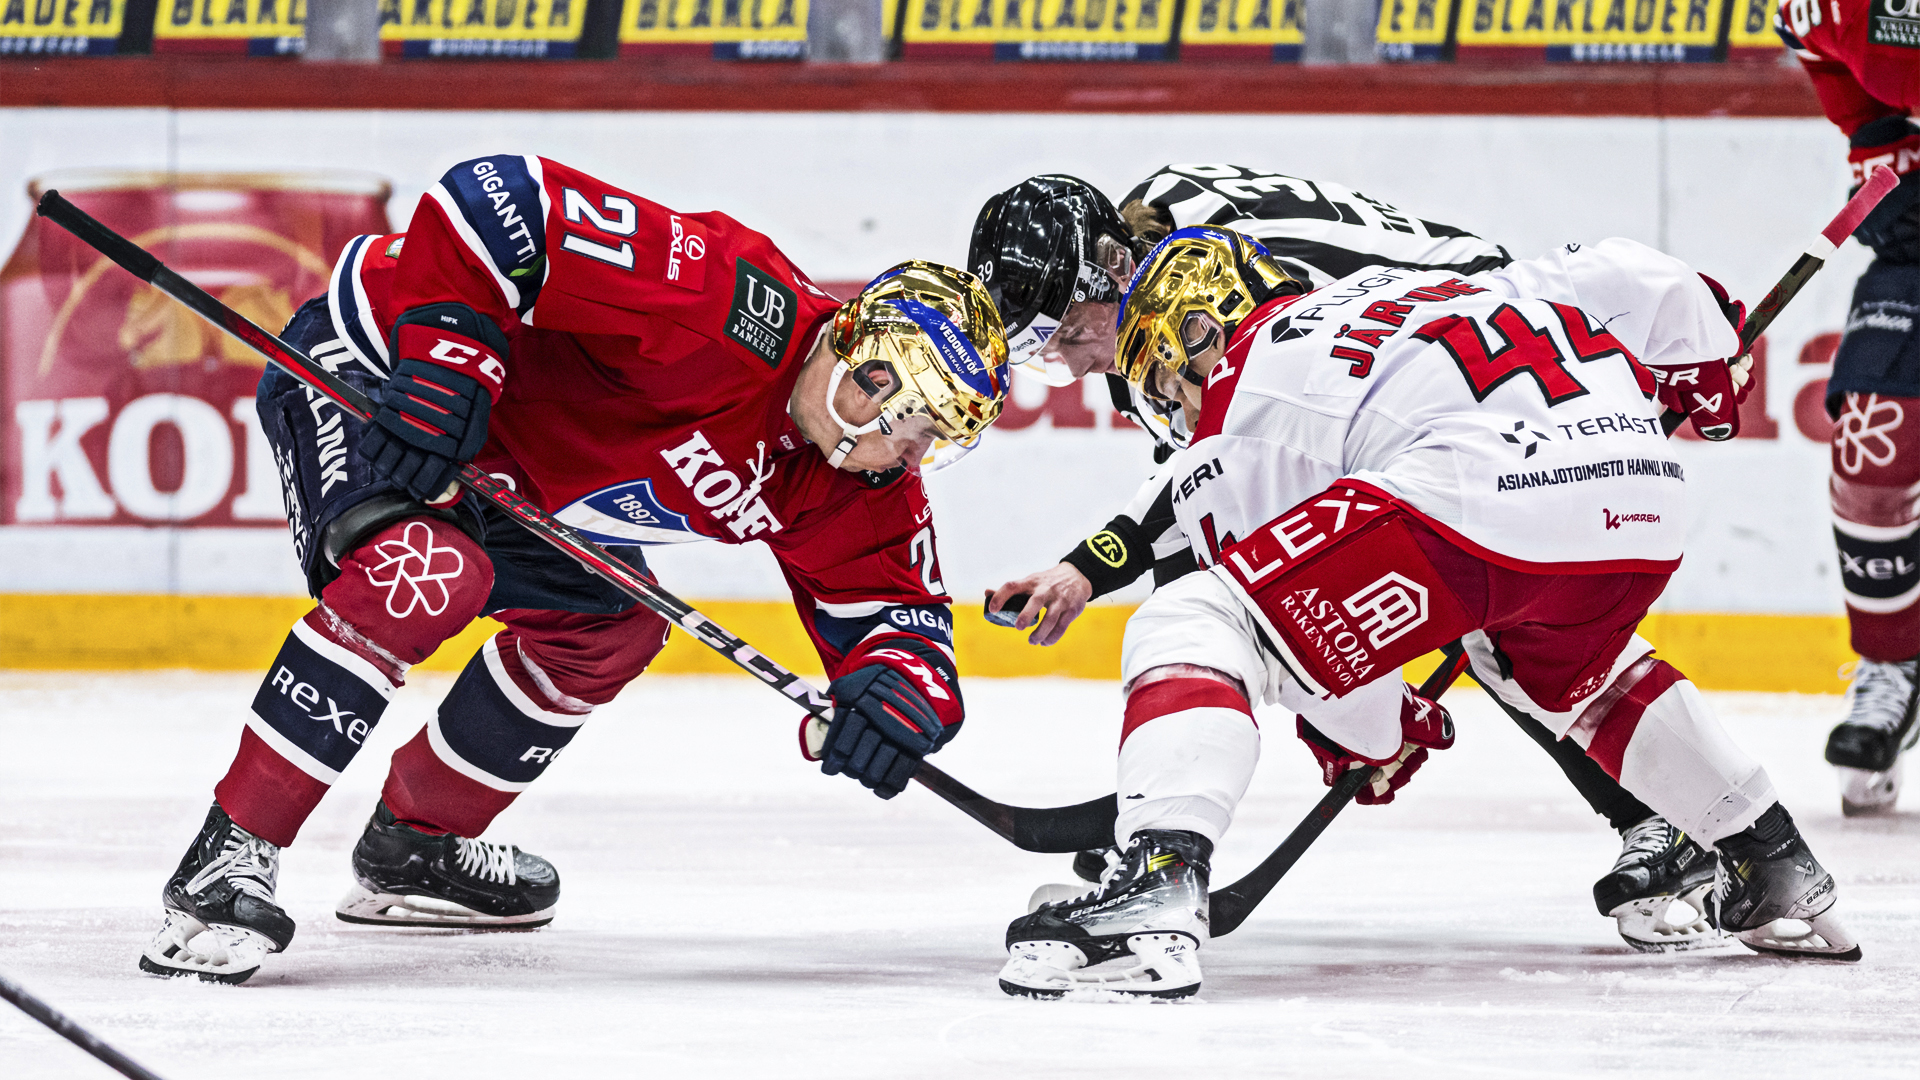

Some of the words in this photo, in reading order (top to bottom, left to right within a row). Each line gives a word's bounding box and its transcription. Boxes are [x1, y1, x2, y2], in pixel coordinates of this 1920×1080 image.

[472, 161, 538, 264] GIGANTTI
[561, 186, 640, 272] 21
[667, 214, 682, 282] LEXUS
[977, 260, 994, 284] 39
[440, 314, 459, 325] HIFK
[745, 273, 786, 330] UB
[732, 322, 778, 361] BANKERS
[739, 316, 777, 349] UNITED
[1409, 297, 1660, 409] 44
[1497, 459, 1625, 493] ASIANAJOTOIMISTO
[1626, 458, 1661, 477] HANNU
[612, 493, 661, 525] 1897
[1280, 594, 1345, 674] RAKENNUS
[1294, 586, 1376, 680] ASTORA
